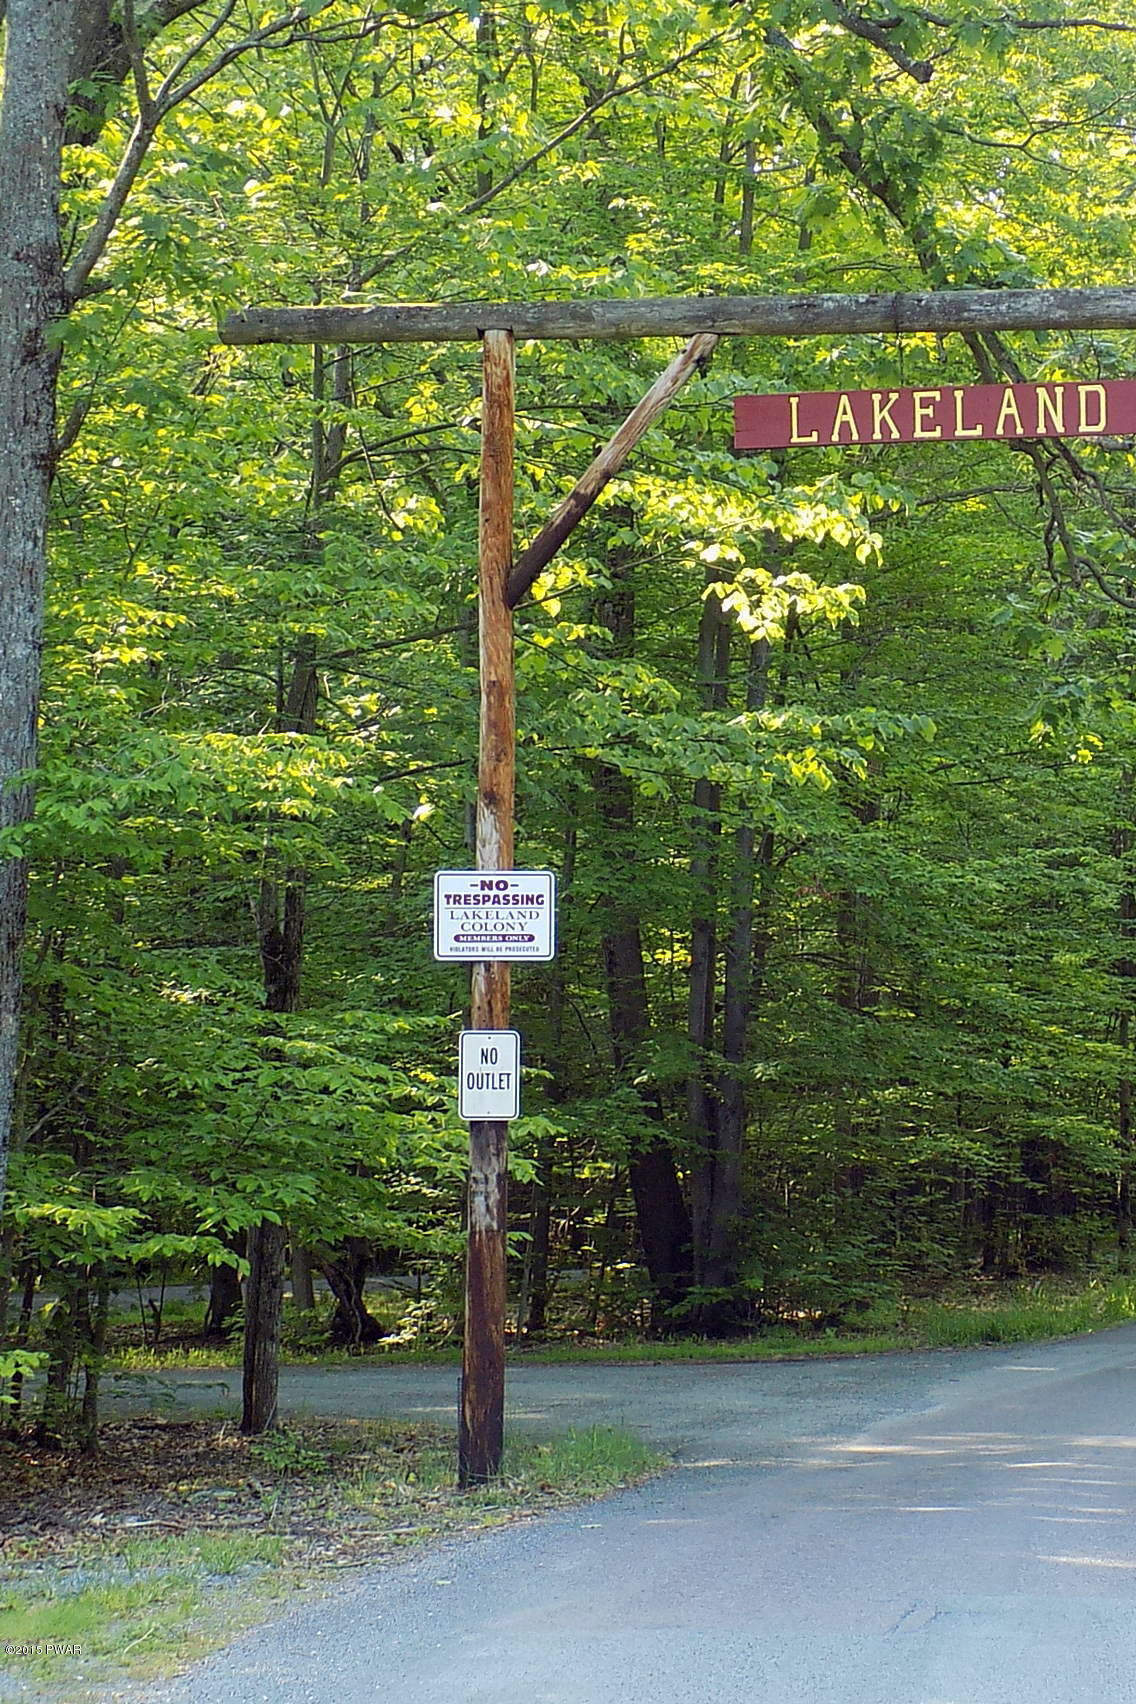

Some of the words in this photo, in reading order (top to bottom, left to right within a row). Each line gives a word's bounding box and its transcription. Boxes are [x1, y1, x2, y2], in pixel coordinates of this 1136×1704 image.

[788, 383, 1107, 444] LAKELAND
[444, 894, 545, 906] TRESPASSING
[449, 910, 541, 920] LAKELAND
[460, 921, 528, 932] COLONY
[480, 1047, 498, 1065] NO
[466, 1072, 512, 1090] OUTLET
